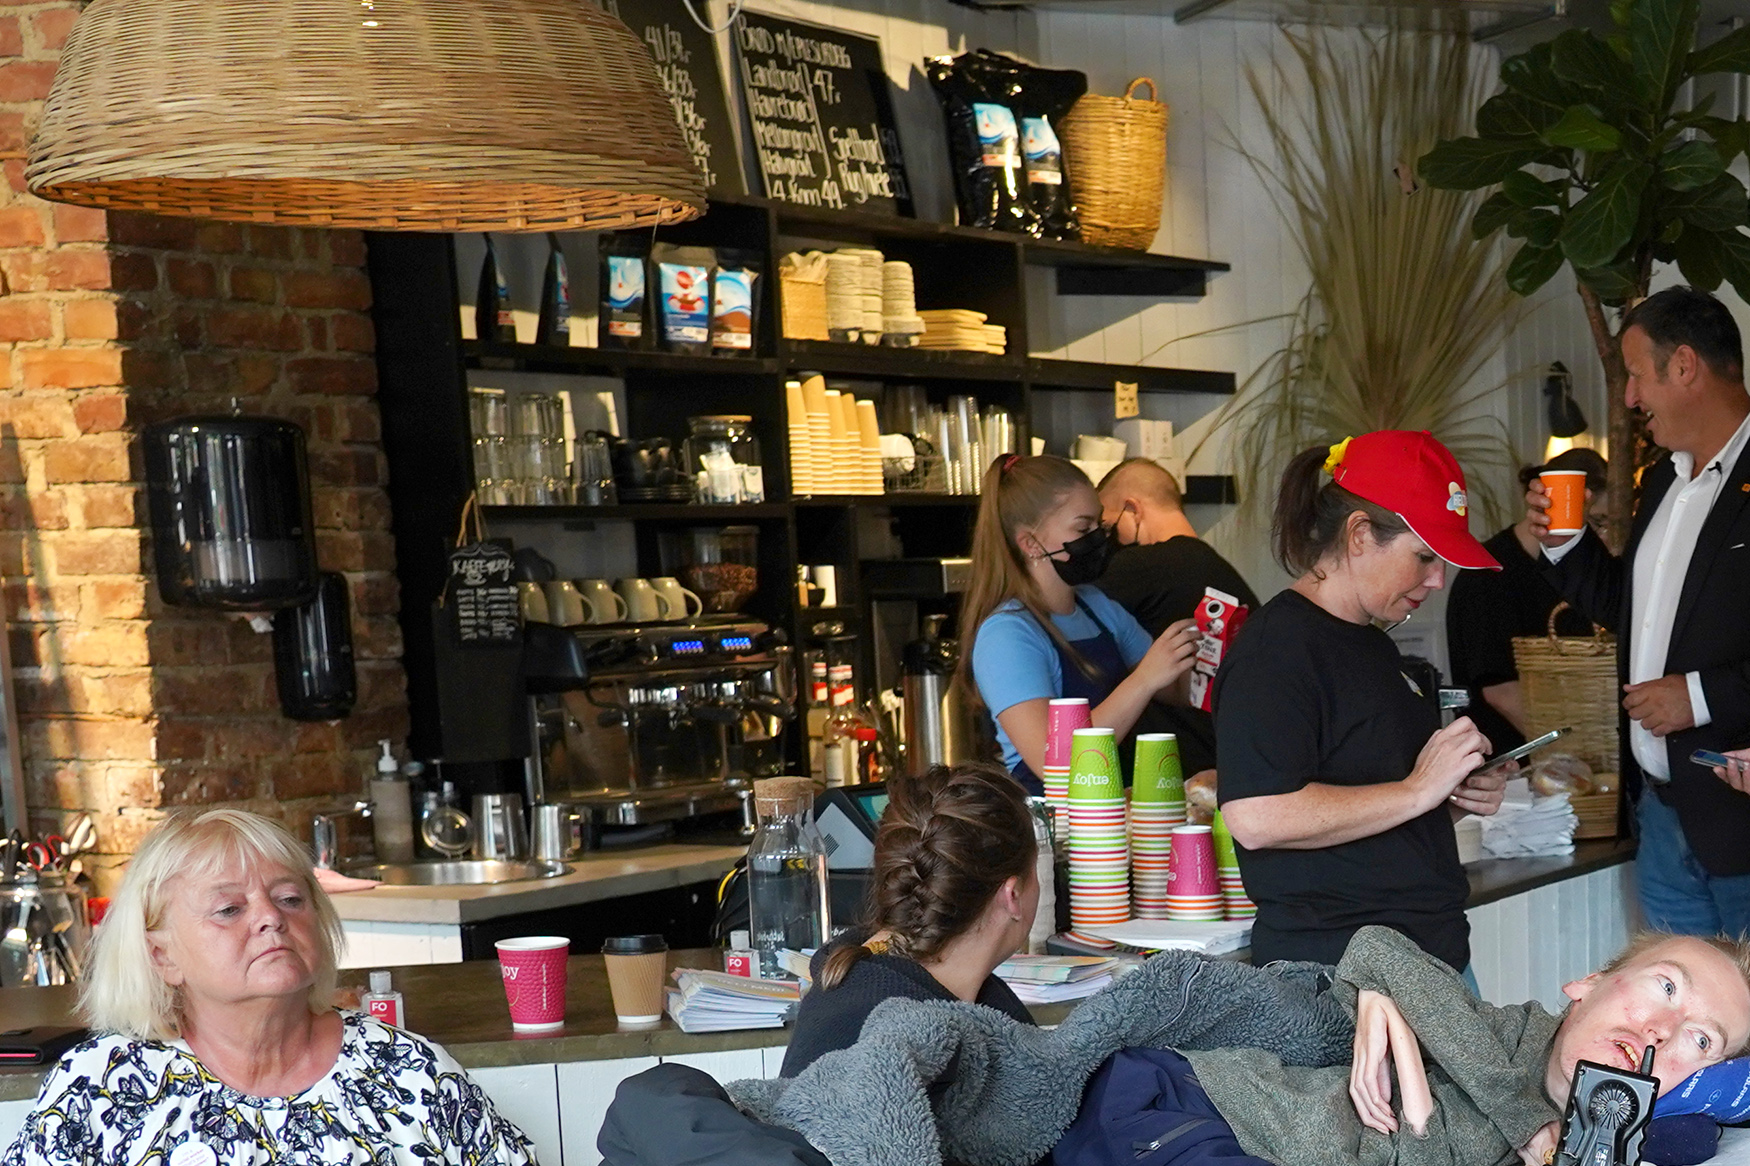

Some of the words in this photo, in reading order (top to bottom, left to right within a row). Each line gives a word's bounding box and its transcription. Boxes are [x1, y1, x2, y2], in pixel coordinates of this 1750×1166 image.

[1072, 772, 1110, 788] enjoy
[728, 958, 742, 967] FO
[371, 1002, 388, 1012] FO
